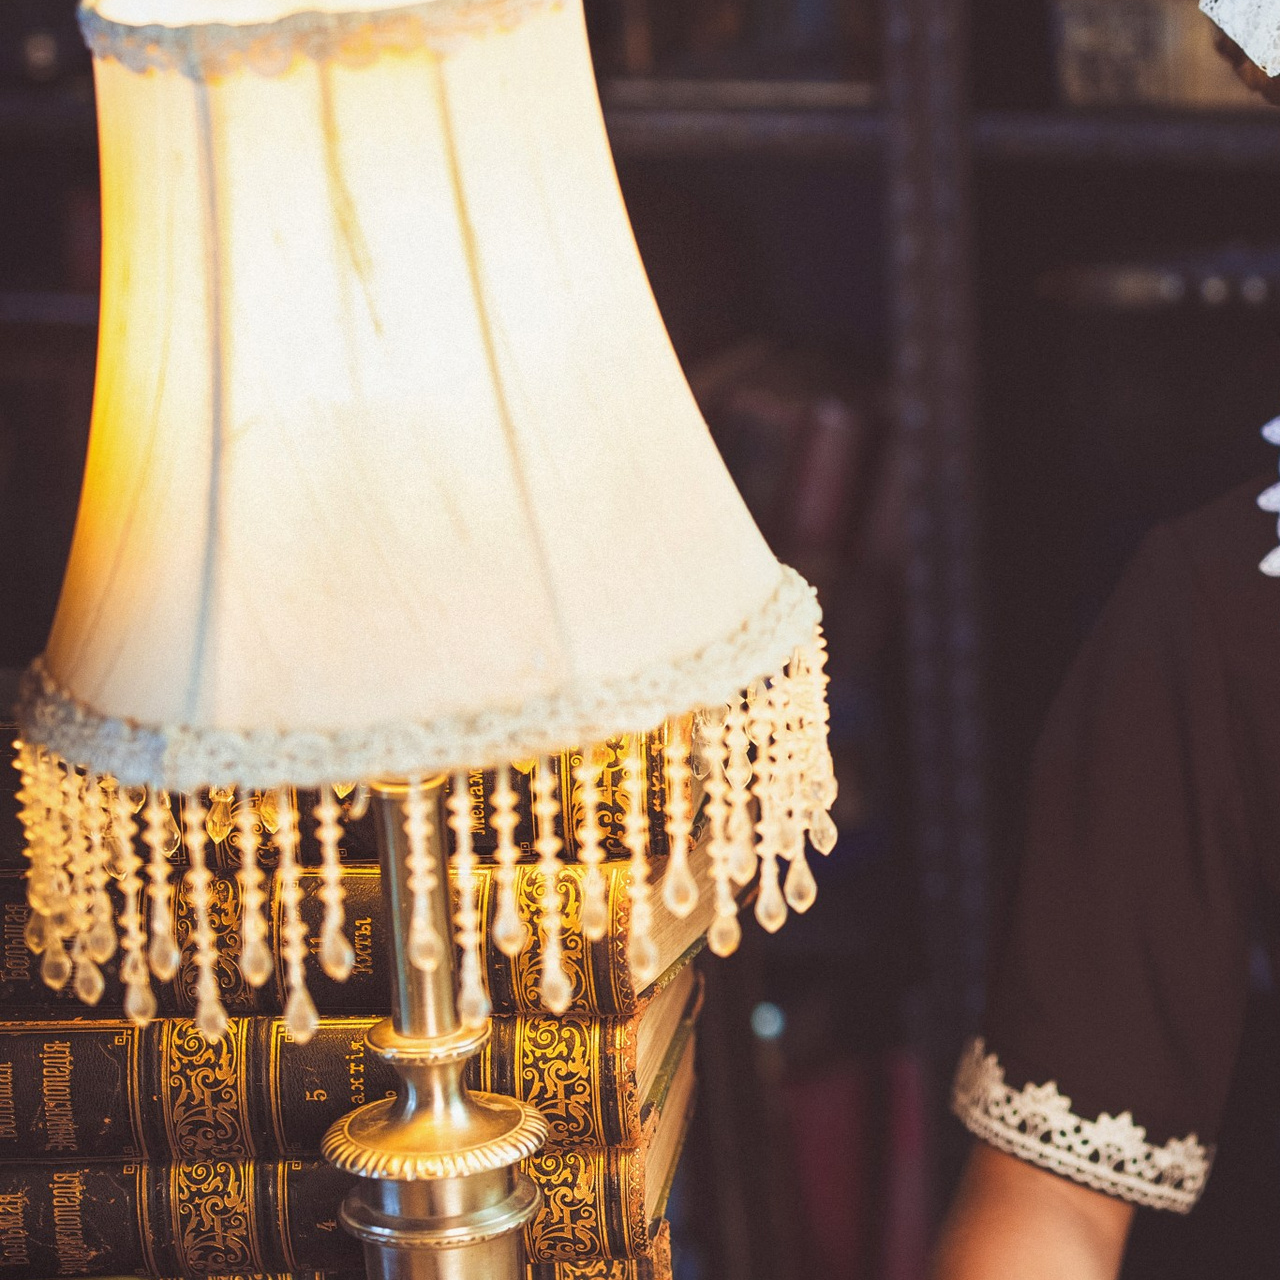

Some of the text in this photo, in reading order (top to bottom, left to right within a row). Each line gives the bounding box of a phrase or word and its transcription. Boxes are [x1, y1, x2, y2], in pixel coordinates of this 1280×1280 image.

[468, 769, 485, 835] Мелам
[352, 916, 373, 975] Киты
[305, 1088, 328, 1102] 5
[345, 1039, 365, 1104] антія
[316, 1220, 338, 1232] 4
